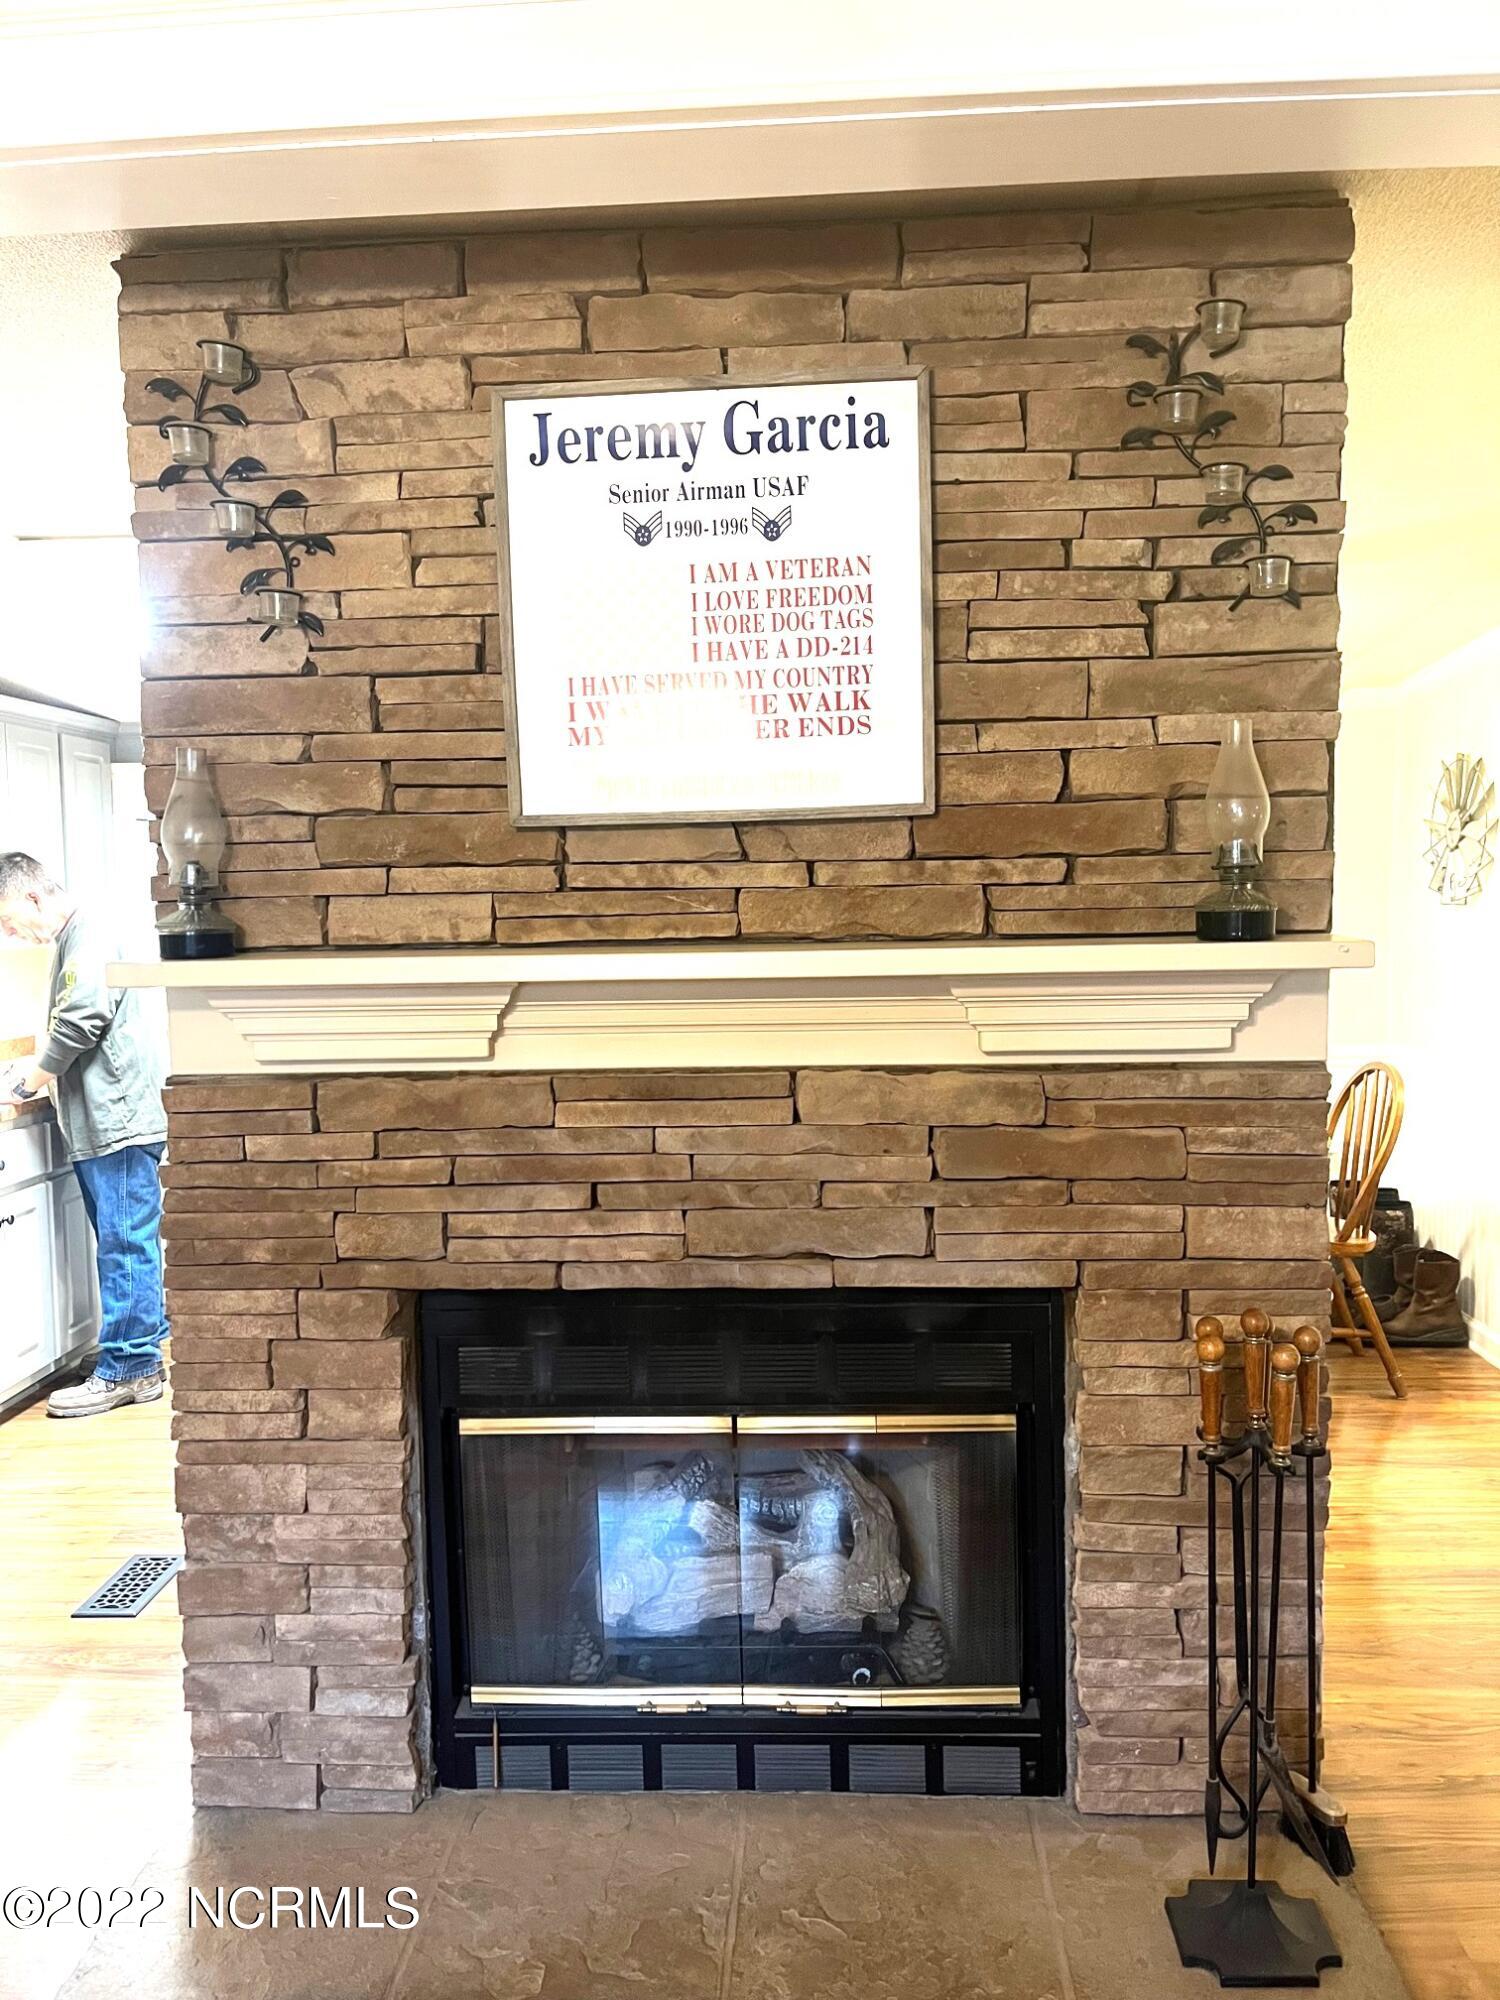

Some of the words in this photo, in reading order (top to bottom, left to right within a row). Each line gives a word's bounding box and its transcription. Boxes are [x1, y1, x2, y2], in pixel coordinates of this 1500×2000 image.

[529, 412, 706, 472] Jeremy
[723, 395, 890, 455] Garcia
[608, 482, 669, 504] Senior
[676, 481, 746, 501] Airman
[753, 475, 809, 498] USAF
[664, 518, 749, 538] 1990-1996
[689, 564, 697, 584] I
[704, 562, 738, 583] AM
[746, 561, 759, 582] A
[765, 555, 871, 580] VETERAN
[691, 592, 698, 612] I
[705, 590, 758, 611] LOVE
[766, 584, 873, 609] FREEDOM
[691, 616, 698, 636] I
[704, 613, 764, 634] WORE
[771, 611, 815, 632] DOG
[820, 608, 874, 630] TAGS
[691, 642, 699, 663] I
[707, 639, 768, 662] HAVE
[776, 638, 790, 659] A
[796, 635, 873, 658] DD-214
[568, 677, 575, 697] I
[582, 675, 637, 696] HAVE
[735, 669, 766, 689] MY
[773, 664, 873, 689] COUNTRY
[568, 702, 576, 722] I
[787, 690, 872, 713] WALK
[568, 726, 608, 747] MY
[798, 715, 872, 737] ENDS
